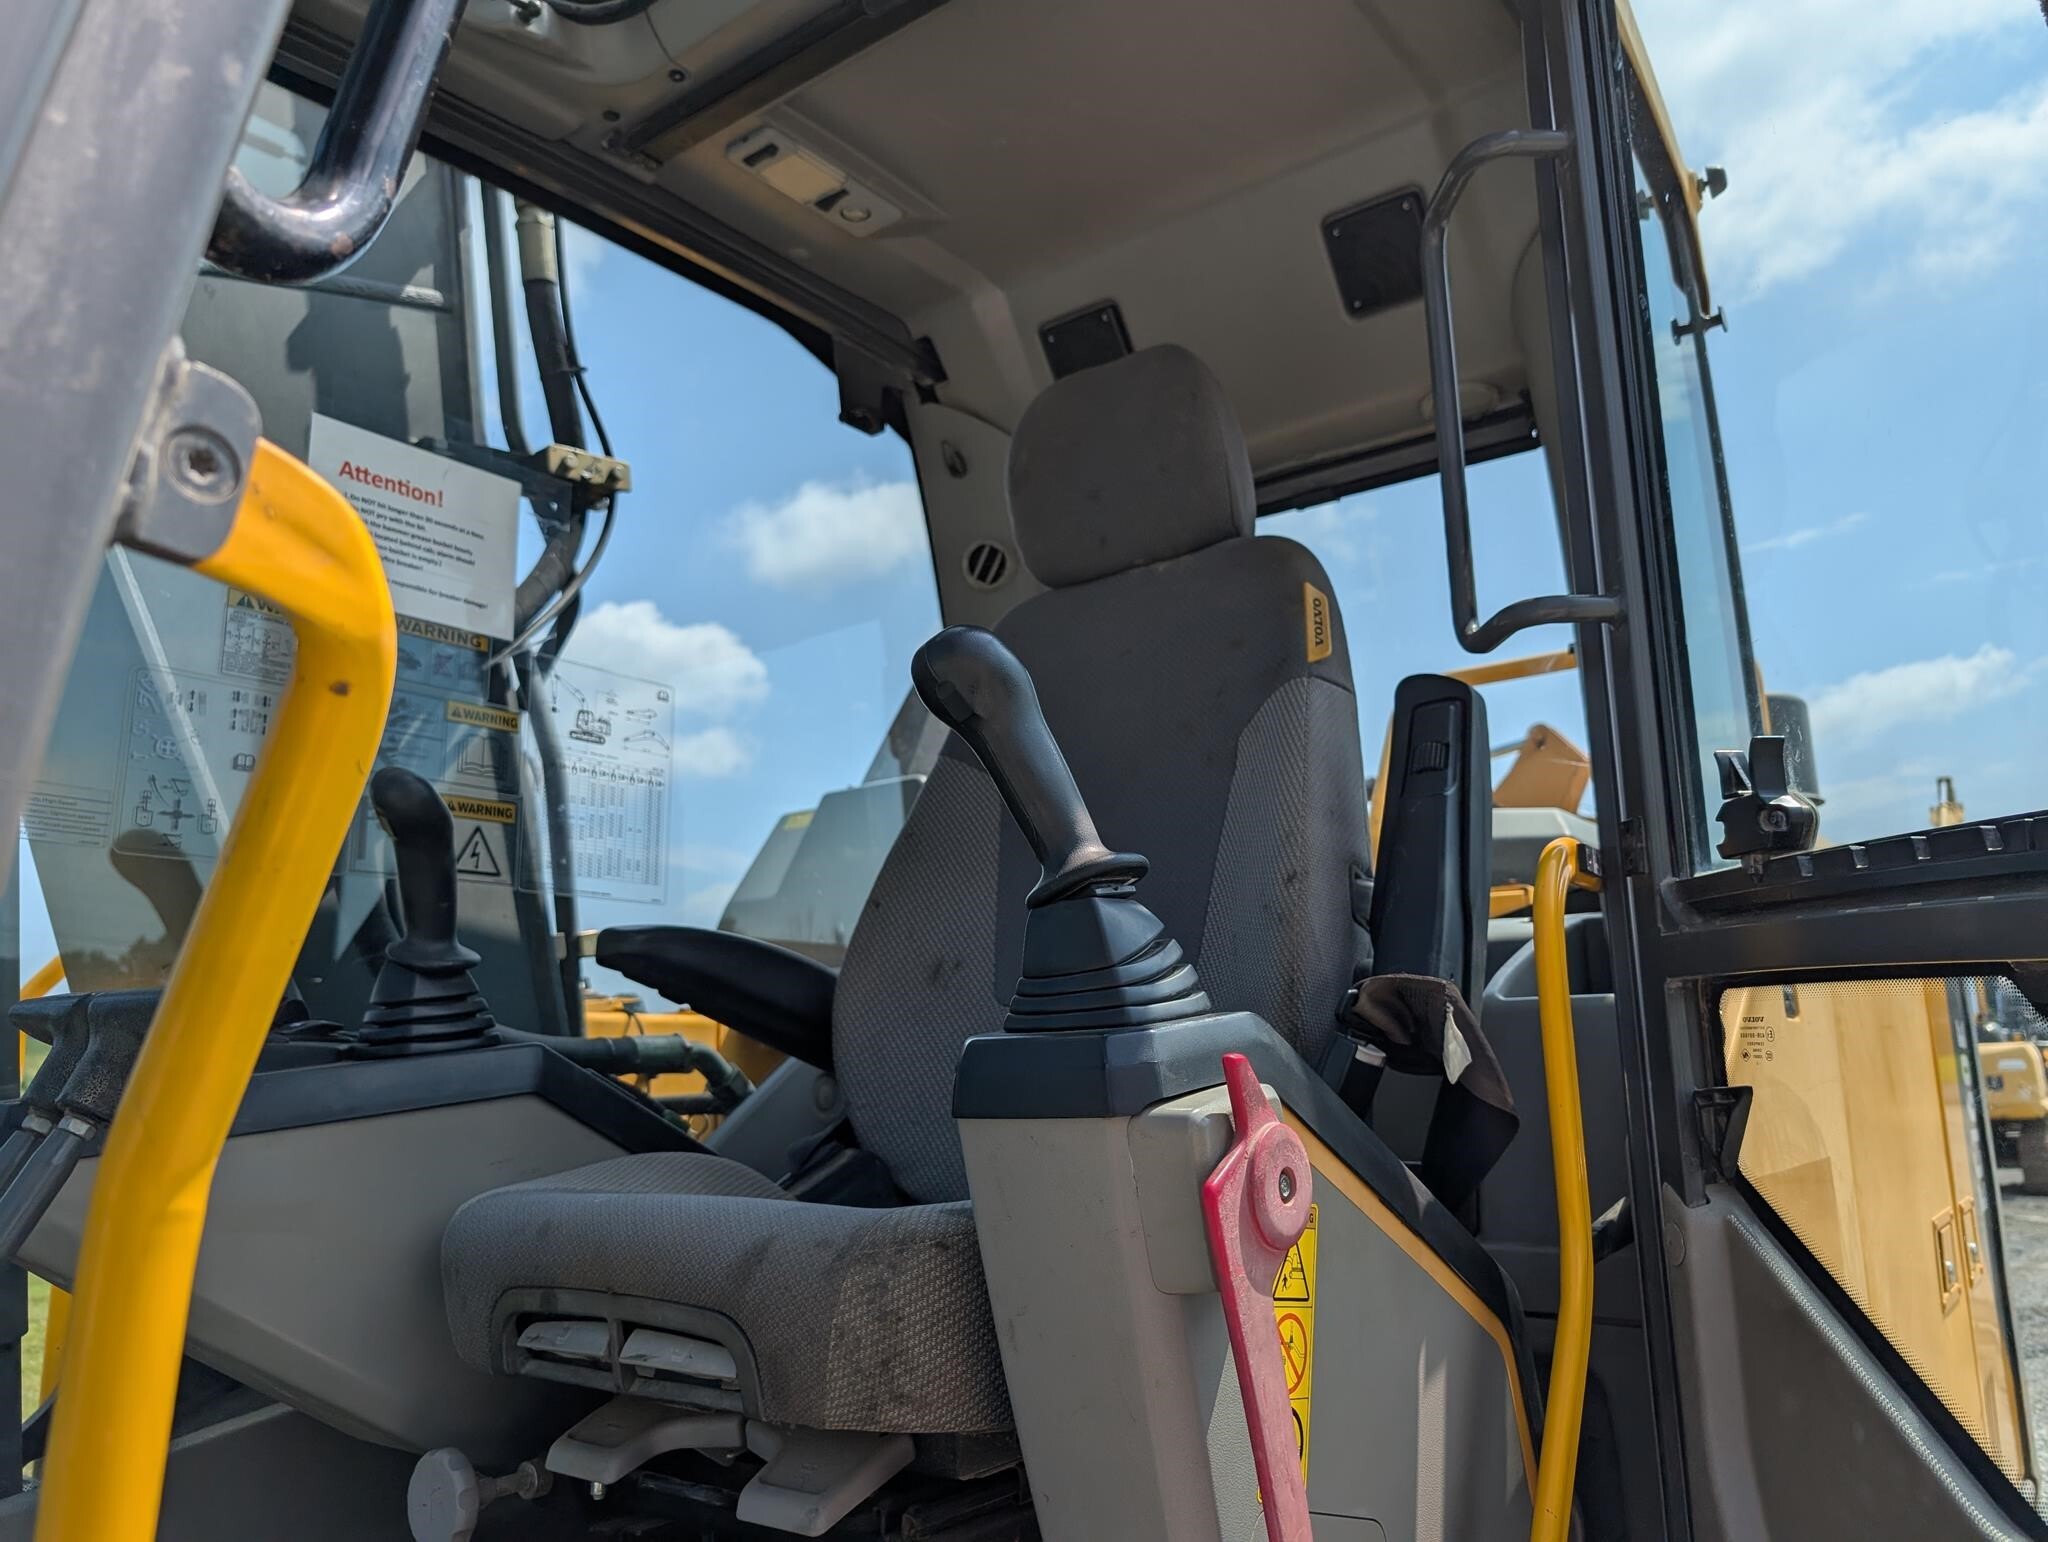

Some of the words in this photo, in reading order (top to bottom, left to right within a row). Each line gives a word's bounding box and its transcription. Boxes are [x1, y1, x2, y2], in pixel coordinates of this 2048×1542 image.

[339, 461, 444, 507] Attention!
[360, 506, 375, 516] NOT
[388, 515, 404, 524] with
[404, 520, 416, 528] the
[361, 497, 376, 506] NOT
[387, 506, 408, 516] longer
[409, 511, 424, 520] than
[433, 520, 458, 530] seconds
[369, 519, 381, 528] the
[382, 524, 410, 535] hammer
[410, 533, 431, 543] grease
[432, 539, 453, 548] bucket
[373, 532, 398, 543] located
[399, 539, 422, 550] behind
[436, 549, 454, 560] alarm
[388, 546, 410, 556] bucket
[390, 579, 428, 593] responsible
[428, 586, 438, 596] for
[438, 591, 462, 601] breaker
[1313, 598, 1324, 647] VOLVO
[464, 710, 518, 728] WARNING
[457, 802, 513, 819] WARNING
